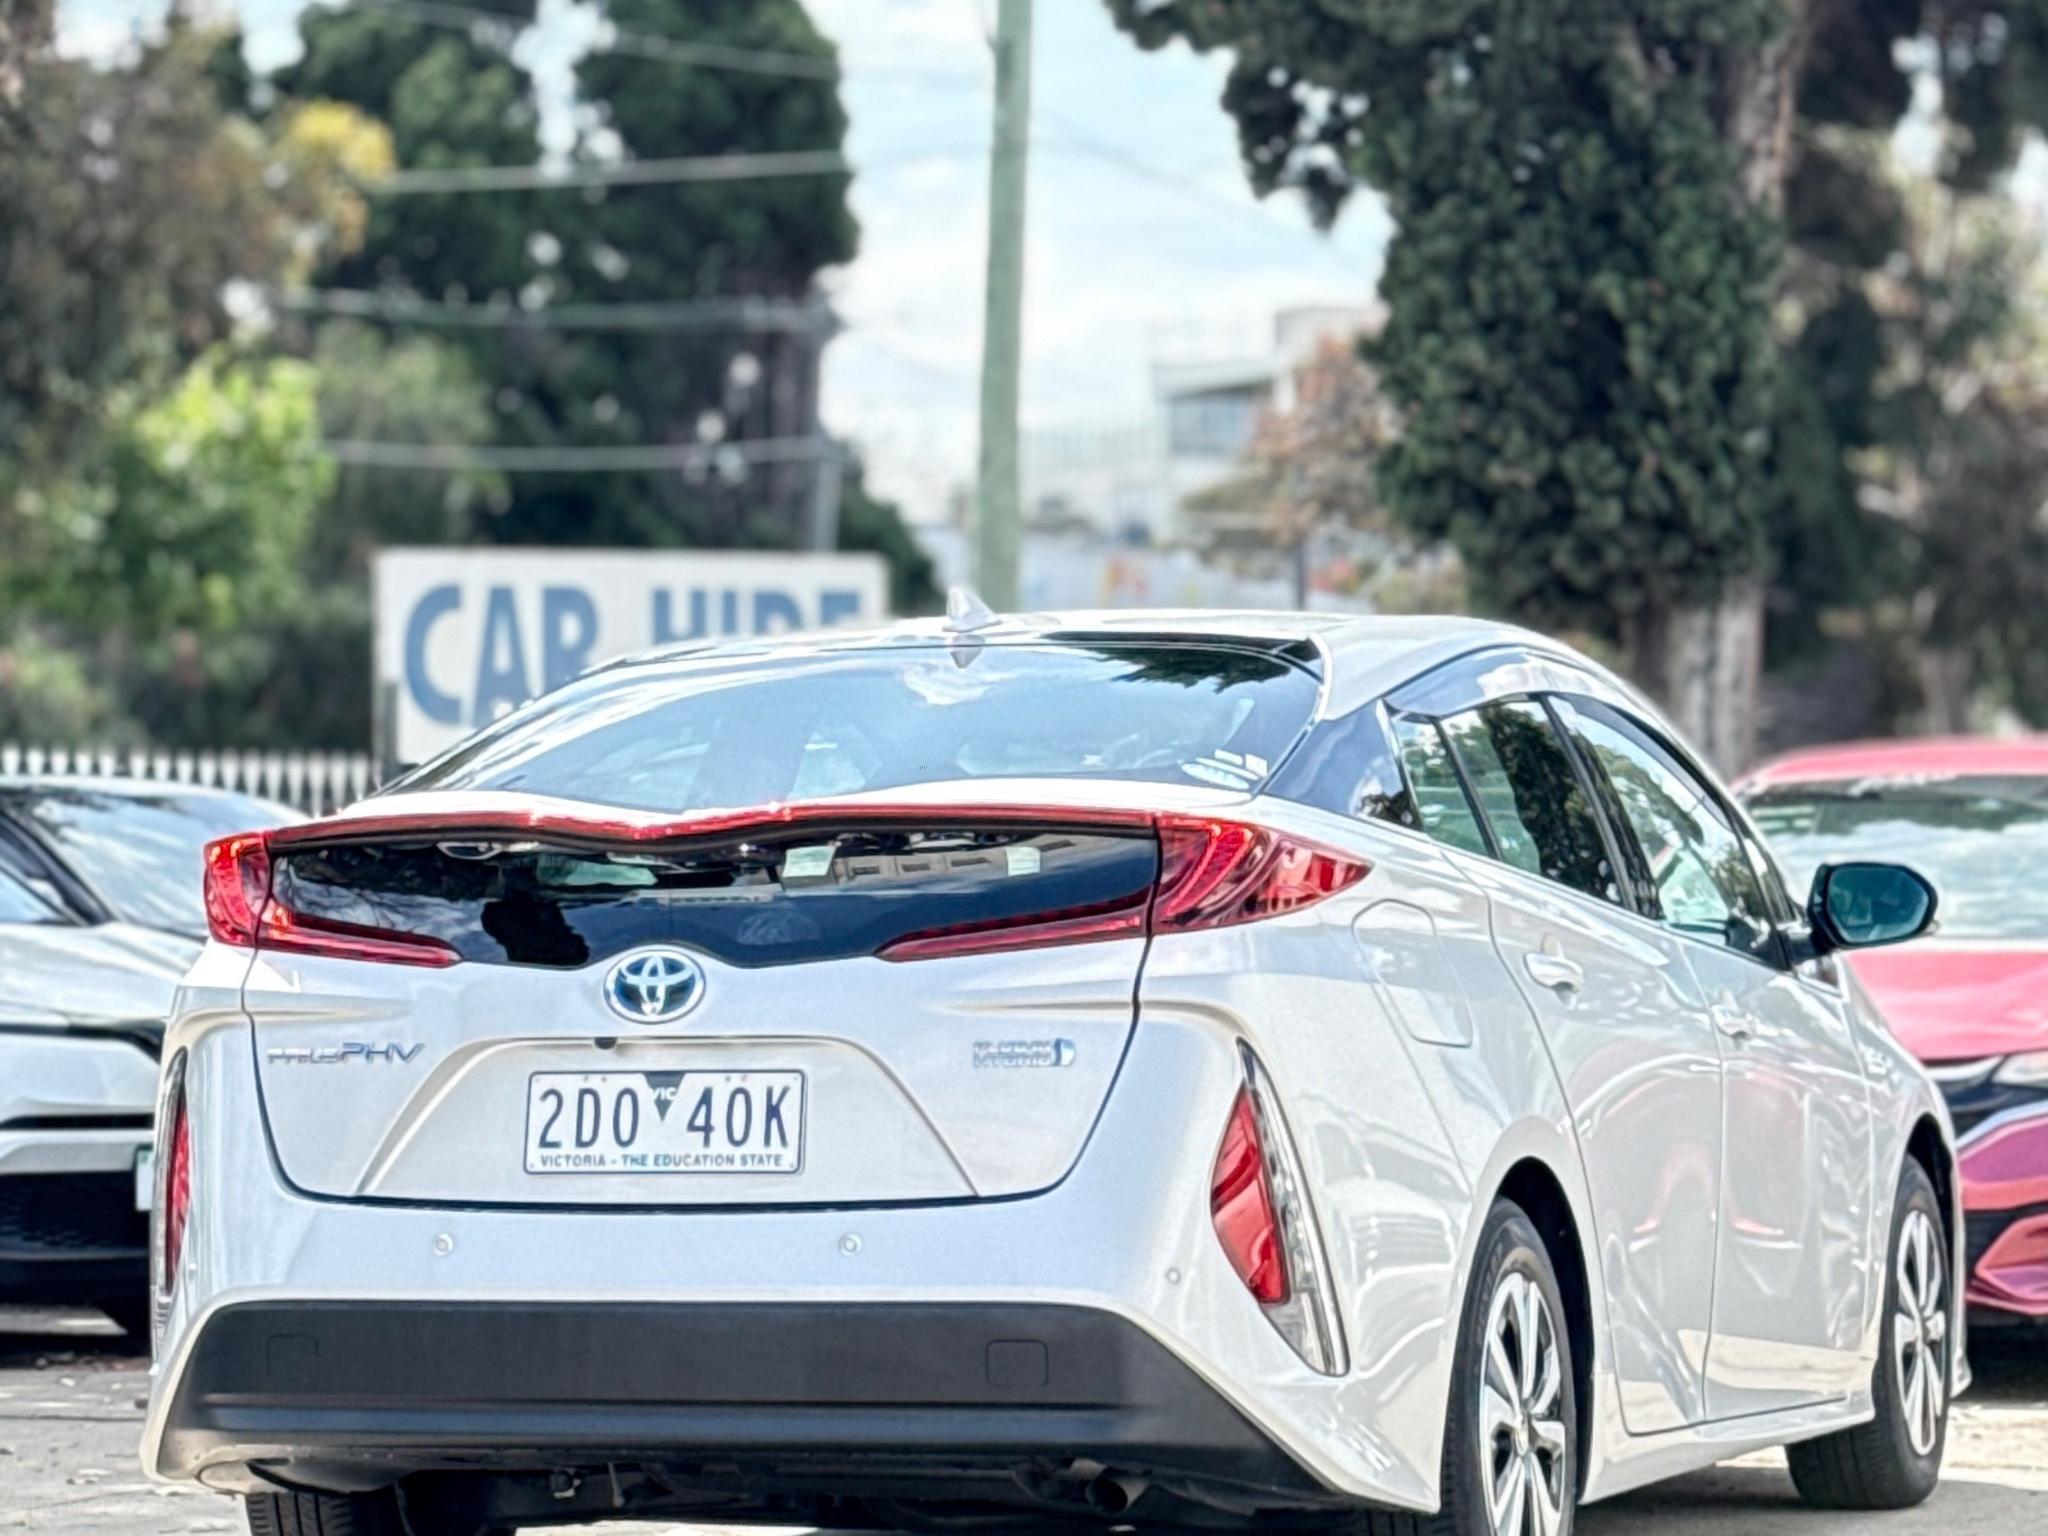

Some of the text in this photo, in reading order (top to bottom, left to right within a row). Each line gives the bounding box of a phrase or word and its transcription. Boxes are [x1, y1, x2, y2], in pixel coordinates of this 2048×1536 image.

[403, 584, 599, 727] CAR
[650, 1087, 677, 1100] VIC
[540, 1154, 607, 1168] VICTORIA
[621, 1154, 649, 1167] THE
[653, 1154, 736, 1168] EDUCATION
[739, 1153, 784, 1168] STATE
